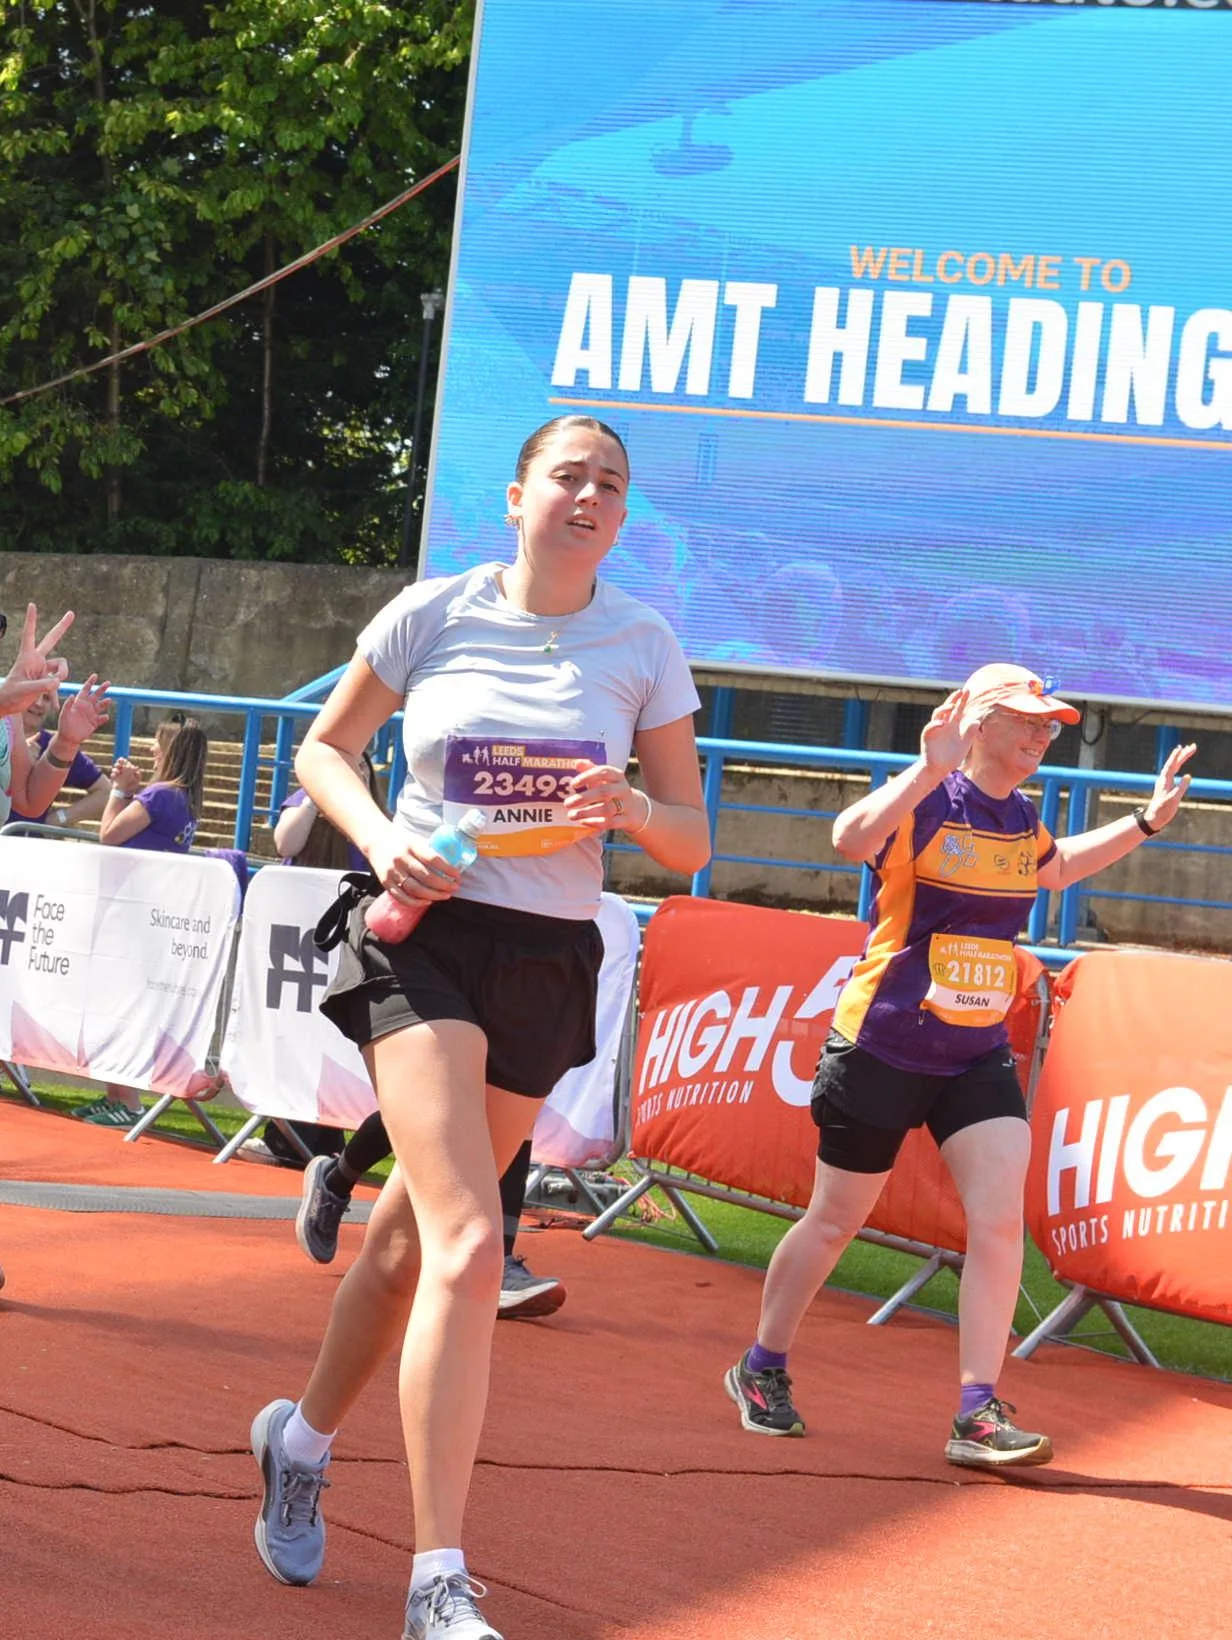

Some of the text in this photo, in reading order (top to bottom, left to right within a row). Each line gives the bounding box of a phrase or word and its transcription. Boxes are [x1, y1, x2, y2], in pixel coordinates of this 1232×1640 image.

[849, 245, 1132, 293] WELCOME TO
[551, 272, 1232, 432] AMT HEADING
[492, 744, 525, 756] LEEDS
[492, 757, 576, 769] HALF MARATHO
[473, 770, 577, 799] 23493
[492, 808, 553, 823] ANNIE
[33, 893, 65, 921] Face
[149, 908, 211, 934] Skincare and
[32, 921, 54, 946] the
[28, 945, 70, 976] Future
[947, 959, 1006, 988] 21812
[954, 993, 990, 1007] SUSAN
[665, 1080, 754, 1112] NUTRITION
[1051, 1199, 1229, 1257] SPORTS NUTRITI
